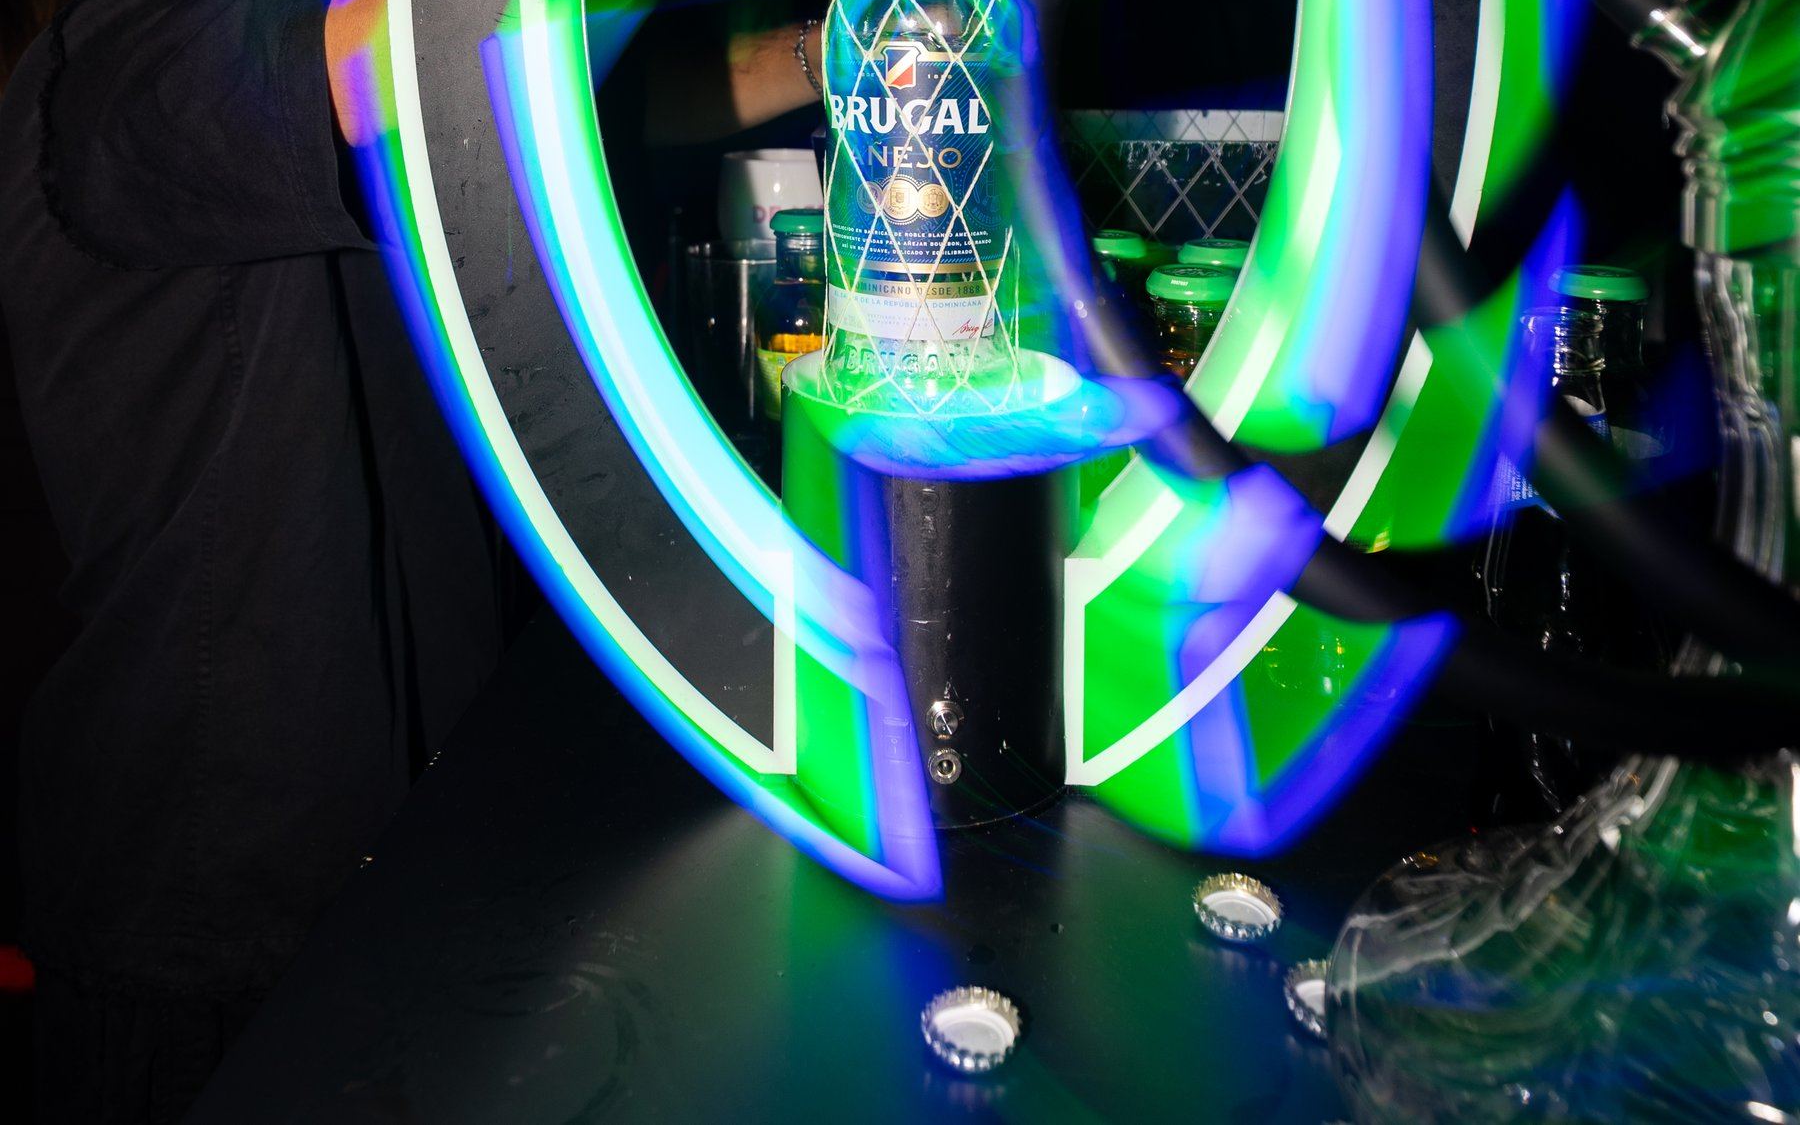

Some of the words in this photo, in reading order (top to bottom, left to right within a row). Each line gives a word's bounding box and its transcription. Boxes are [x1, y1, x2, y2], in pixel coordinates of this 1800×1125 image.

[830, 94, 990, 135] BRUGAL
[955, 230, 989, 238] AMEICANO,
[964, 238, 992, 246] LORANDO
[917, 286, 951, 296] DSDE
[932, 299, 982, 309] DOMINICANA
